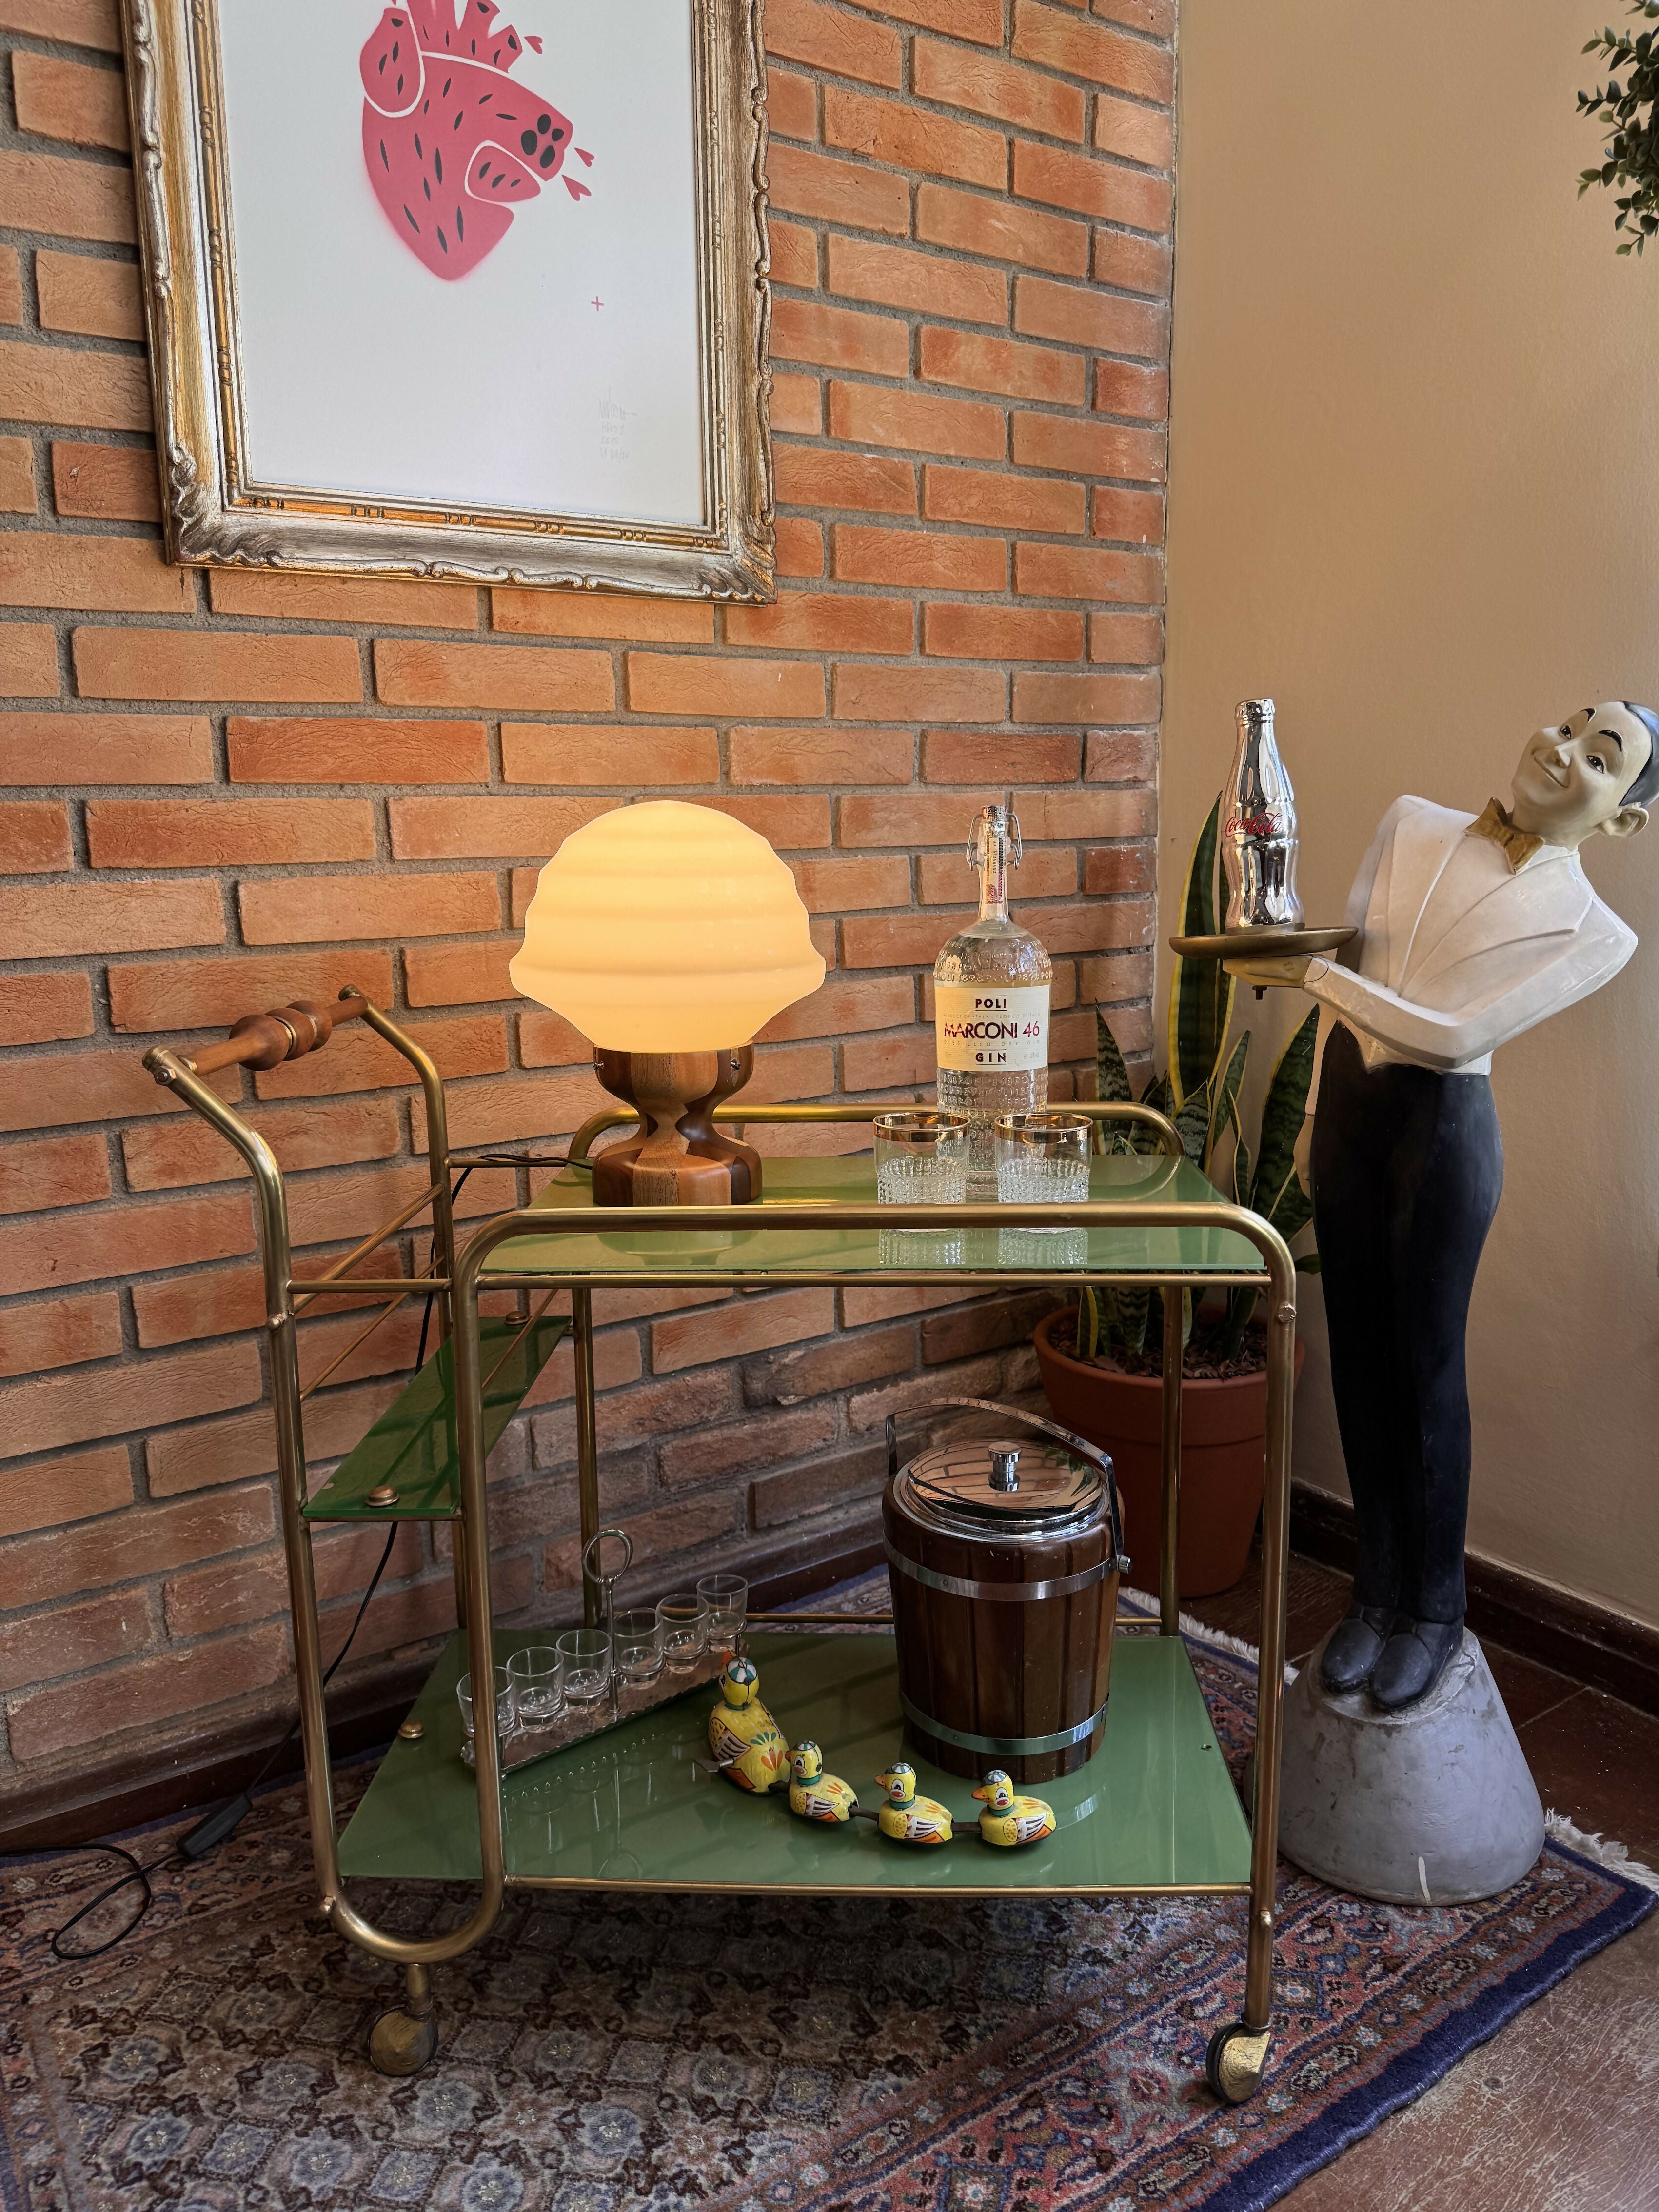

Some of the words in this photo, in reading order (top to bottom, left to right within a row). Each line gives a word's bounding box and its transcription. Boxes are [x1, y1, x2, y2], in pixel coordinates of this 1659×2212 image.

[975, 998, 1007, 1009] POLI
[944, 1020, 1018, 1039] MARCONI
[1022, 1020, 1040, 1037] 46
[975, 1052, 1006, 1062] GIN
